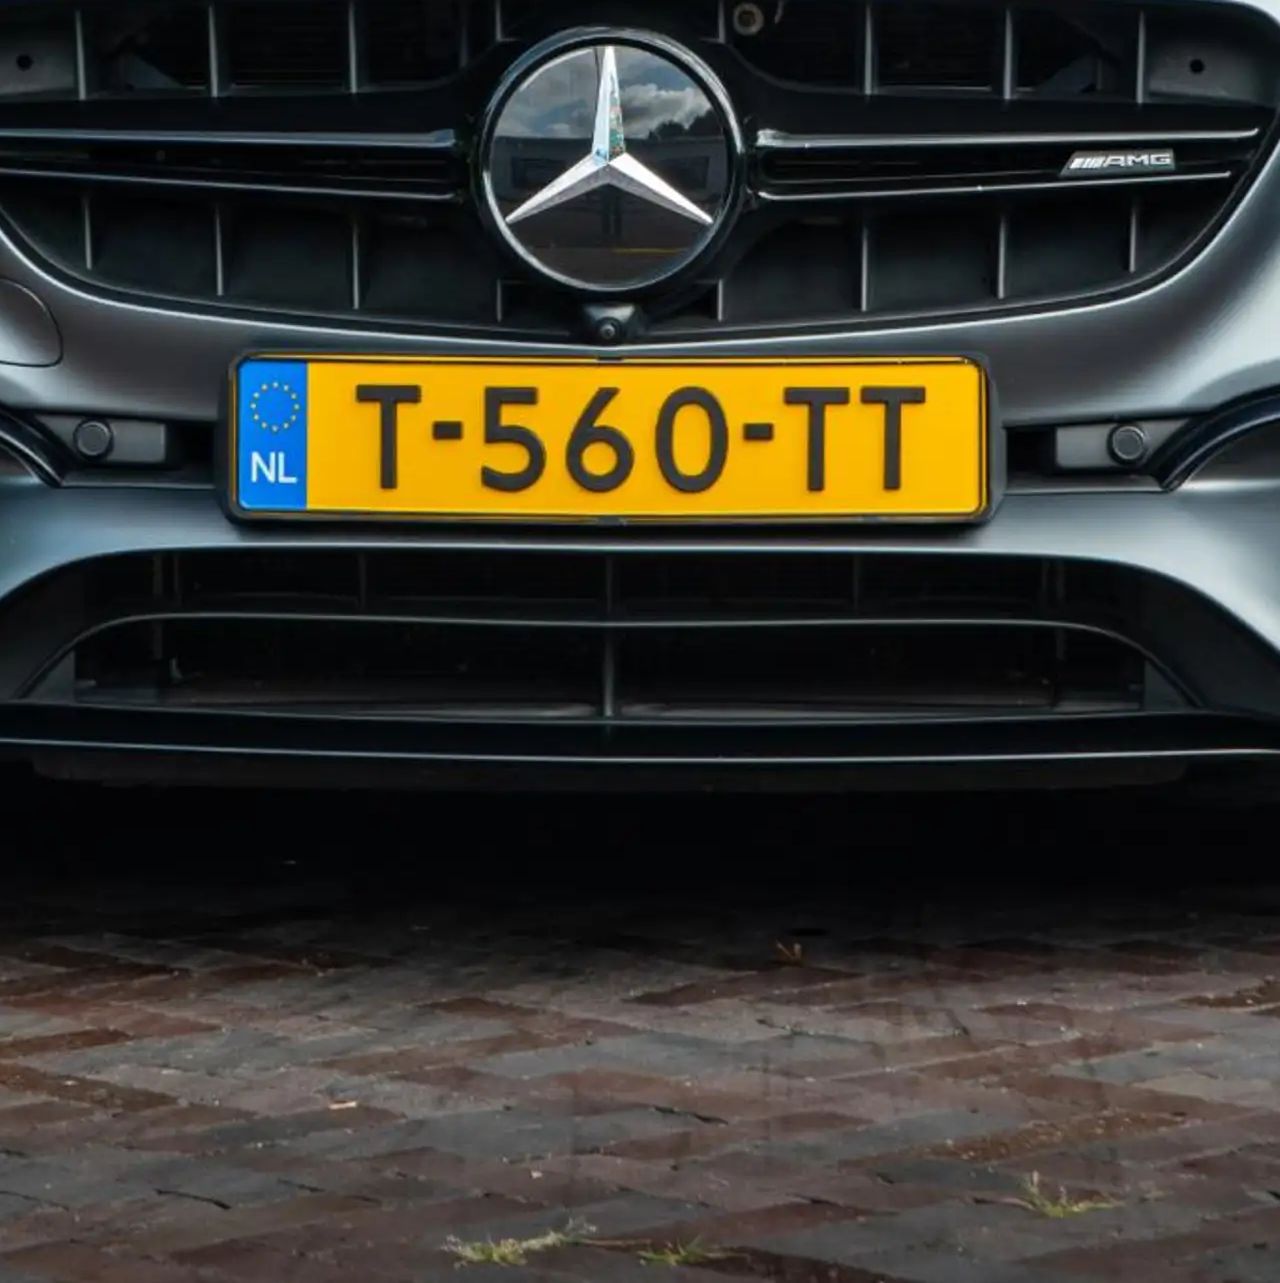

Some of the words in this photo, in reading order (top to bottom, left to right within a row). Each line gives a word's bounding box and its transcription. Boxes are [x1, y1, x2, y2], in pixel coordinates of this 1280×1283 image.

[1102, 153, 1171, 168] AMG
[355, 383, 927, 494] T-560-TT
[250, 450, 298, 484] NL
